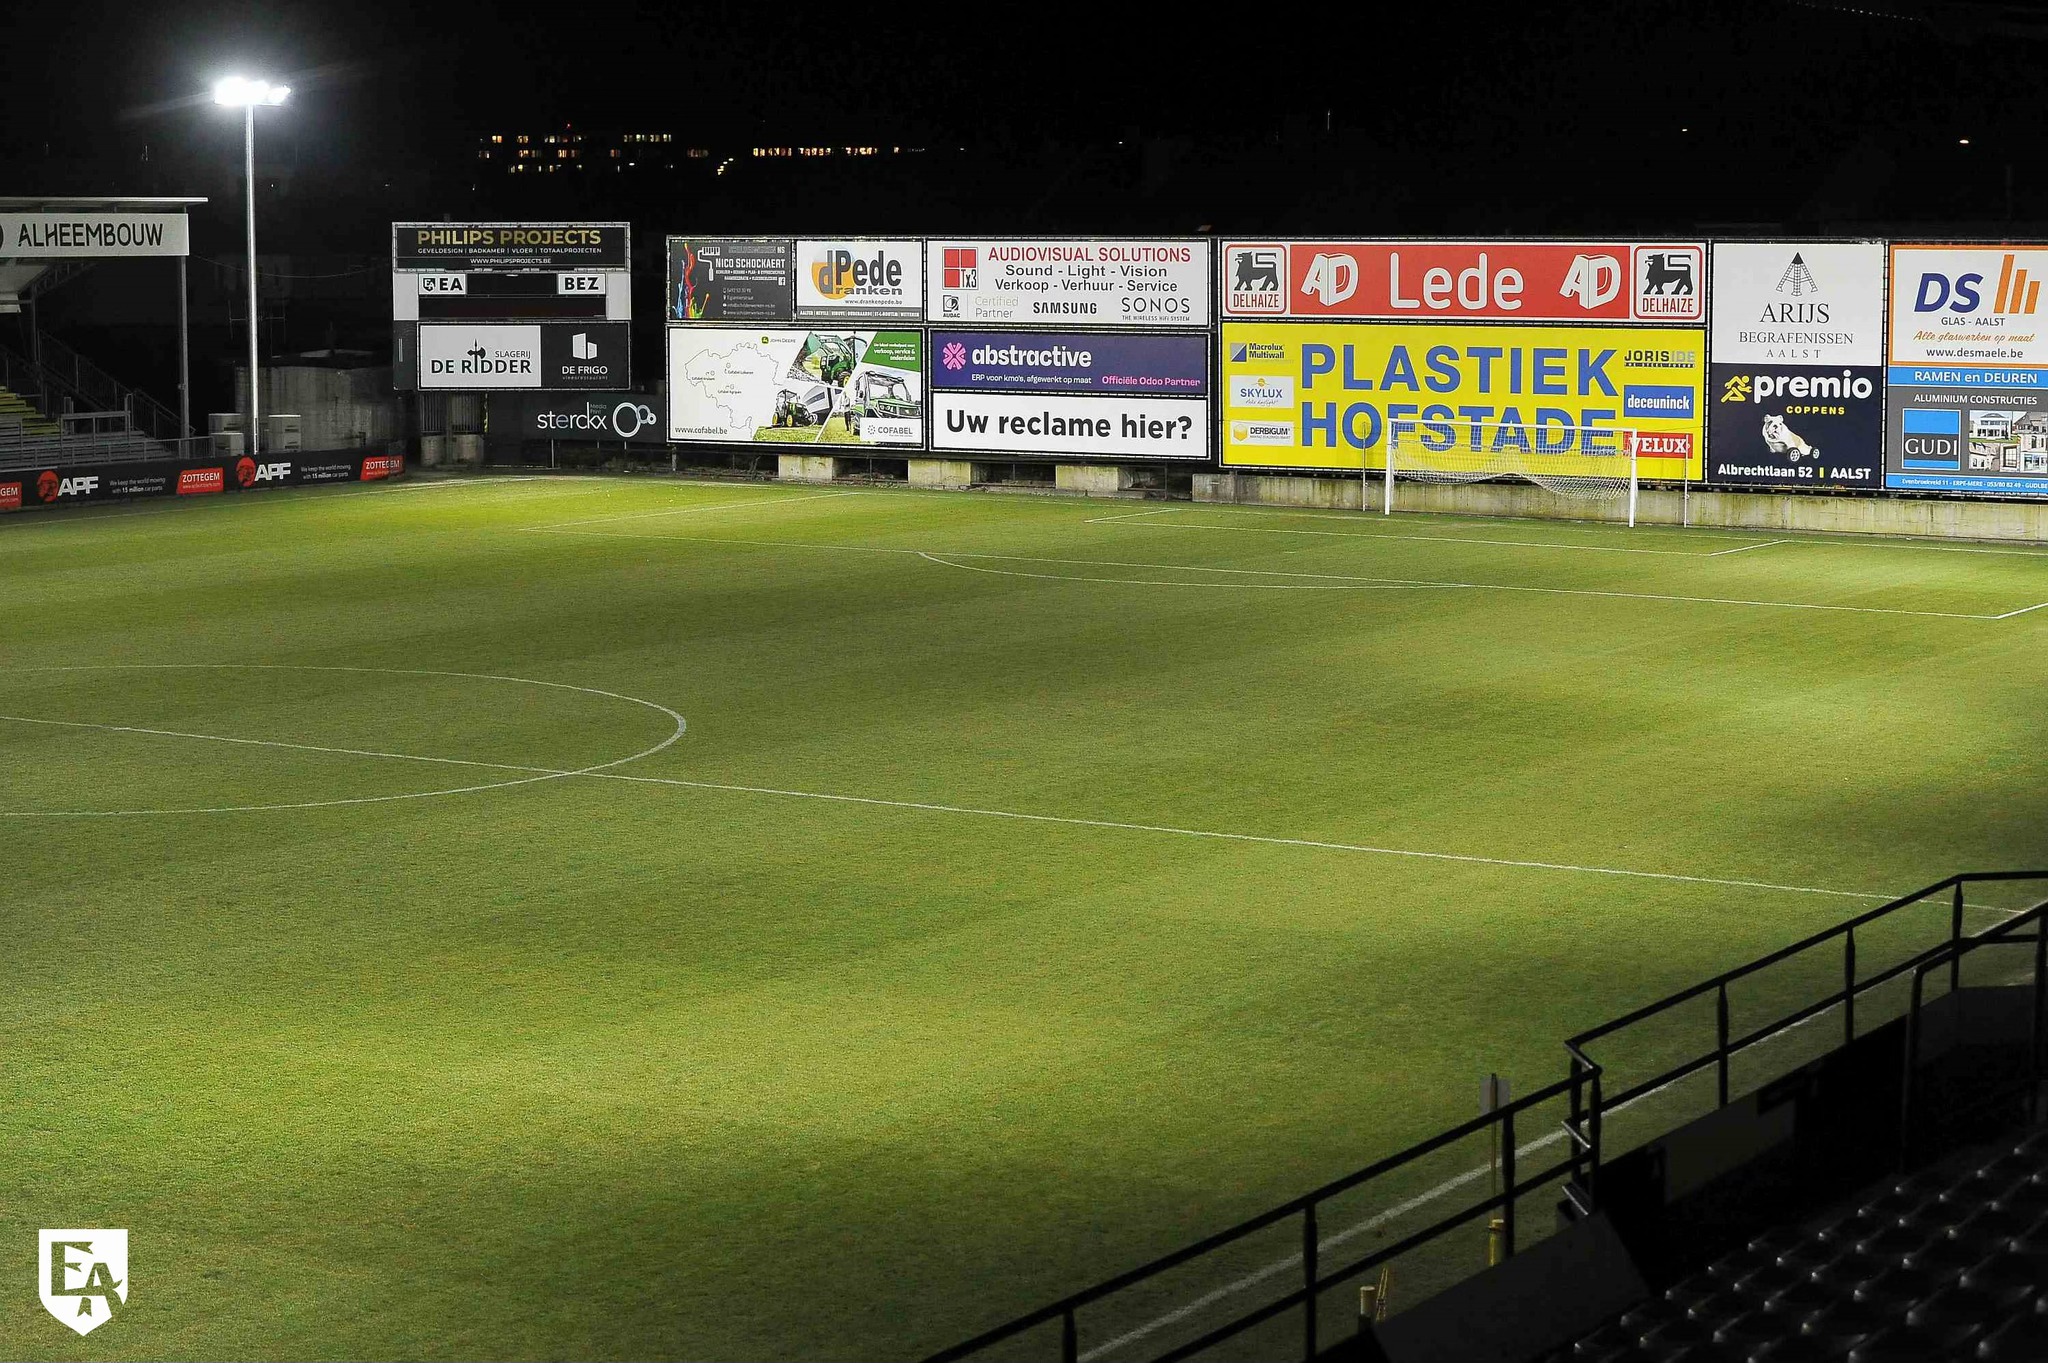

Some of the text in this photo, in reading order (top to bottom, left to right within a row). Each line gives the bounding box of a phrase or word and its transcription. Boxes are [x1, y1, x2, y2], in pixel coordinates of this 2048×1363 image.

[18, 223, 163, 247] ALHEEMBOUW
[417, 230, 601, 245] PHILIPS PROJECTS
[777, 246, 786, 254] NS
[988, 247, 1192, 262] AUDIOVISUAL SOLUTIONS
[715, 258, 786, 269] NICO SCHOCKAERT
[961, 269, 977, 288] Tx3
[1005, 265, 1053, 277] Sound
[1067, 265, 1106, 280] Light
[1120, 265, 1168, 277] Vision
[1300, 252, 1359, 307] AD
[439, 278, 463, 291] EA
[564, 277, 599, 290] BEZ
[995, 279, 1049, 293] Verkoop
[1061, 279, 1115, 292] Verhuur
[1127, 280, 1178, 292] Service
[1390, 252, 1525, 310] Lede
[1559, 254, 1622, 310] AD
[1913, 272, 1984, 313] DS
[975, 296, 1019, 307] Certified
[1033, 301, 1097, 314] SAMSUNG
[1121, 297, 1190, 313] SONOS
[1233, 293, 1279, 308] DELHAIZE
[1642, 297, 1694, 313] DELHAIZE
[975, 307, 1013, 318] Partner
[1759, 303, 1830, 324] ARIJS
[1941, 316, 1966, 326] GLAS
[1975, 316, 2006, 327] AALST
[1739, 331, 1854, 345] BEGRAFENISSEN
[1913, 330, 2035, 344] Alle glaswerken op maat
[1249, 343, 1284, 351] Macrolux
[1766, 349, 1822, 359] AALST
[1926, 347, 2024, 359] www.desmaele.be
[495, 350, 531, 359] SLAGERIJ
[972, 344, 1092, 367] abstractive
[1249, 350, 1285, 359] Multiwall
[431, 360, 532, 373] DE RIDDER
[562, 366, 608, 375] DE FRIGO
[1301, 343, 1619, 397] PLASTIEK
[1026, 374, 1062, 385] afgewerkt
[1063, 377, 1073, 385] op
[1102, 375, 1201, 387] Officiële Odoo Partner
[1914, 371, 2038, 384] RAMEN en DEUREN
[1240, 388, 1283, 398] SKYLUX
[1754, 370, 1873, 404] premio
[1627, 394, 1690, 410] deceuninck
[1914, 393, 2038, 405] ALUMINIUM CONSTRUCTIES
[537, 402, 607, 430] sterckx
[1786, 406, 1845, 415] COPPENS
[674, 426, 728, 435] www.cofabel.be
[877, 426, 914, 435] COFABEL
[947, 409, 1192, 440] Uw reclame hier?
[1301, 401, 1617, 455] HOFSTADE
[1905, 438, 1958, 455] GUDI
[365, 459, 400, 470] ZOTTEGEM
[182, 472, 220, 483] ZOTTEGEM
[254, 462, 292, 482] APF
[1718, 464, 1871, 480] Albrechtlaan 52 AALST
[57, 476, 99, 497] APF
[117, 479, 129, 487] keep
